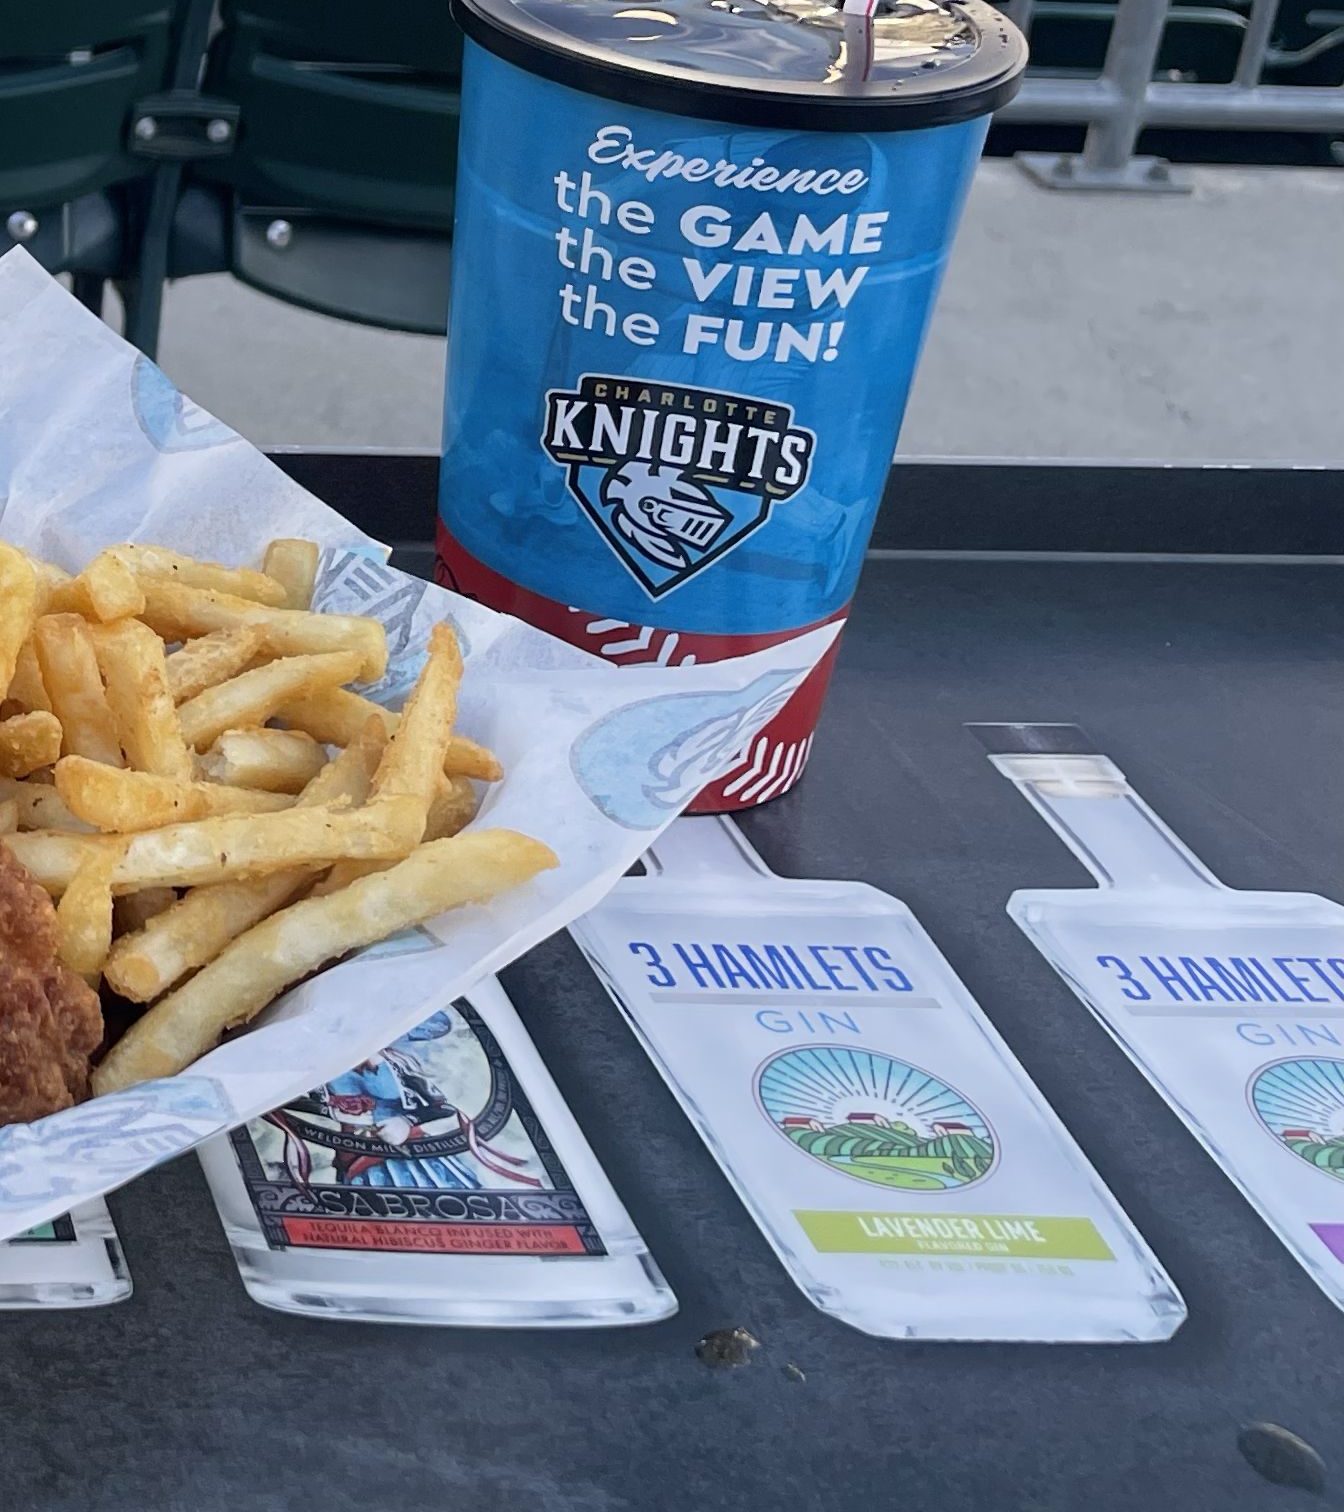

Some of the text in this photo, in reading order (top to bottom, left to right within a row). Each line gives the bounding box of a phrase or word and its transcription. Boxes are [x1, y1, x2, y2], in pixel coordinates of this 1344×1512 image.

[587, 125, 869, 194] Experience
[554, 171, 890, 255] the GAME
[555, 227, 870, 310] the VIEW
[559, 284, 845, 362] the FUN!
[595, 383, 776, 424] CHARLOTTE
[551, 399, 807, 486] KNIGHTS
[629, 942, 914, 992] 3 HAMLETS
[1096, 955, 1344, 1003] 3 HAMLET
[756, 1010, 862, 1034] GIN
[1236, 1023, 1343, 1046] GIN
[304, 1127, 366, 1151] WELDON
[319, 1190, 523, 1219] SABROSA
[303, 1232, 568, 1251] NATURAL HIBISCUS GINGER FLAVOR
[309, 1220, 553, 1240] TEQUILA BLANCO INFUSED WITH
[858, 1216, 1047, 1243] LAVENDER LIME
